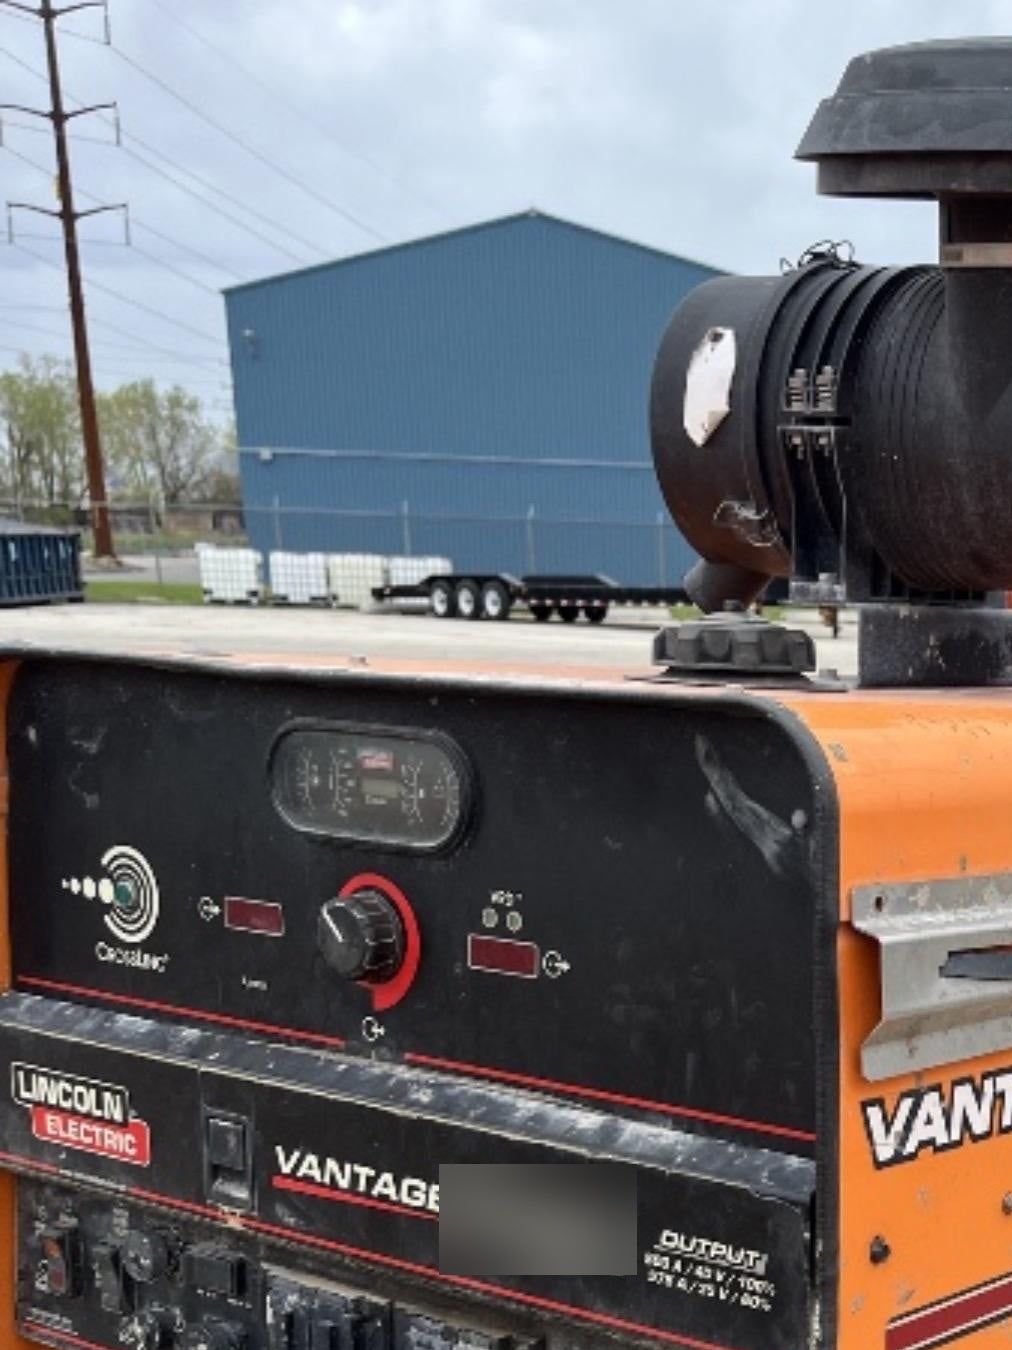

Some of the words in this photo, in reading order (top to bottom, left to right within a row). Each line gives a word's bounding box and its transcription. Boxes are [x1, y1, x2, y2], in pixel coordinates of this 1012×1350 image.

[17, 1070, 124, 1123] LINCOLN
[44, 1111, 137, 1156] ELECTRIC
[659, 1228, 761, 1269] OUTPUT
